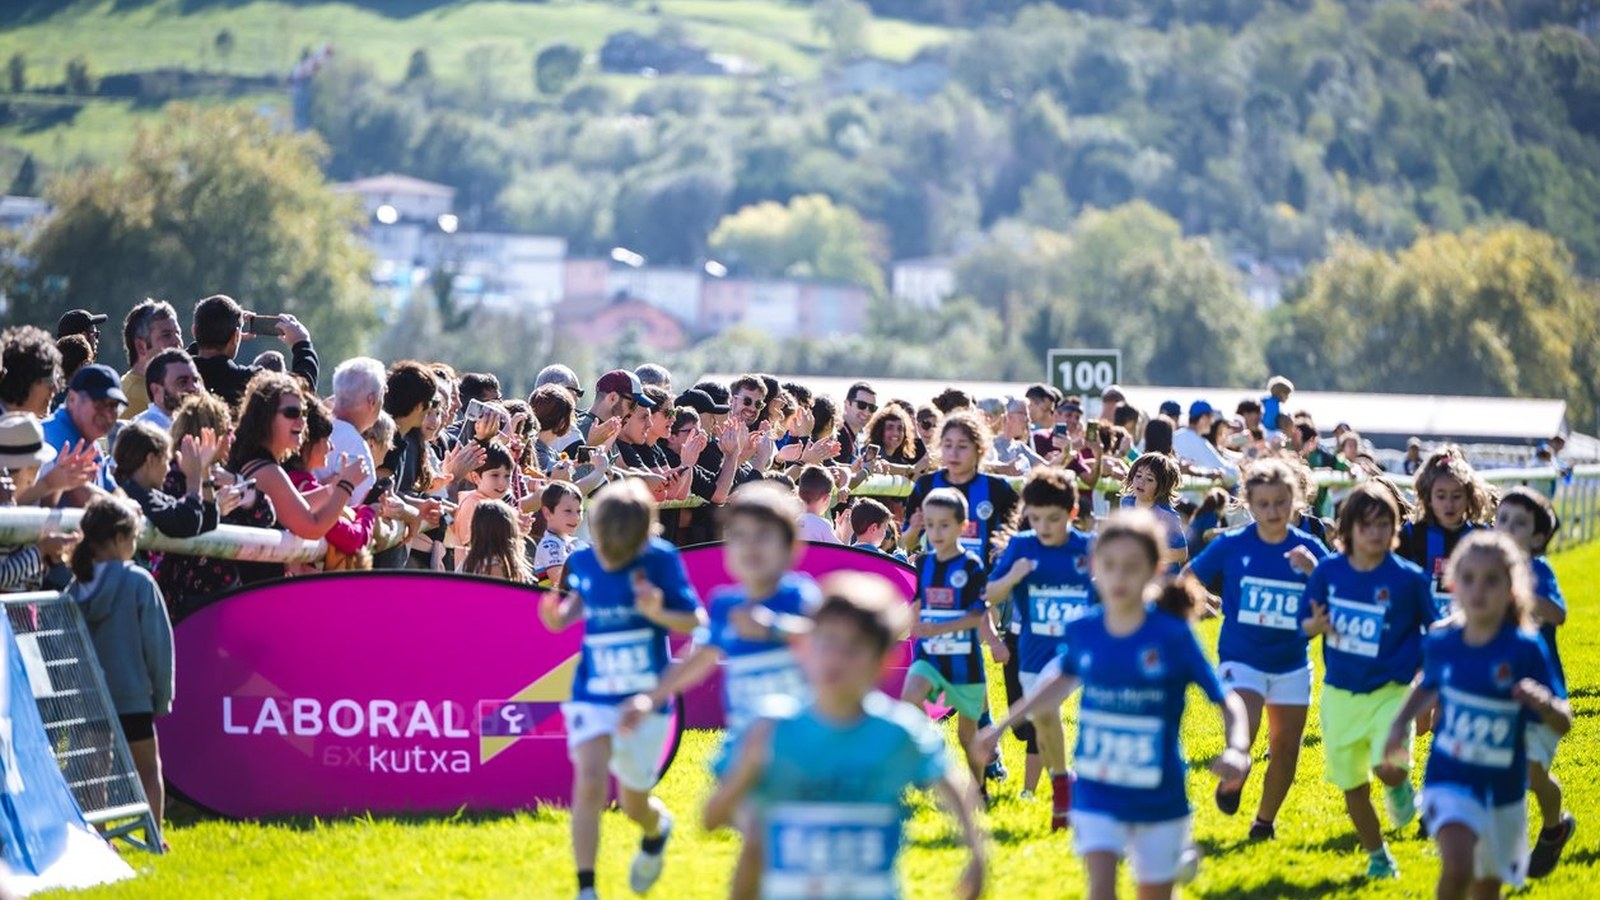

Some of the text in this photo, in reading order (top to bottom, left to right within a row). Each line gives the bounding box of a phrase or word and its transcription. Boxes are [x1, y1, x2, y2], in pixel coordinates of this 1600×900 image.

[1059, 361, 1113, 390] 100
[1249, 587, 1298, 614] 1718
[223, 697, 470, 738] LABORAL
[370, 745, 470, 773] kutxa
